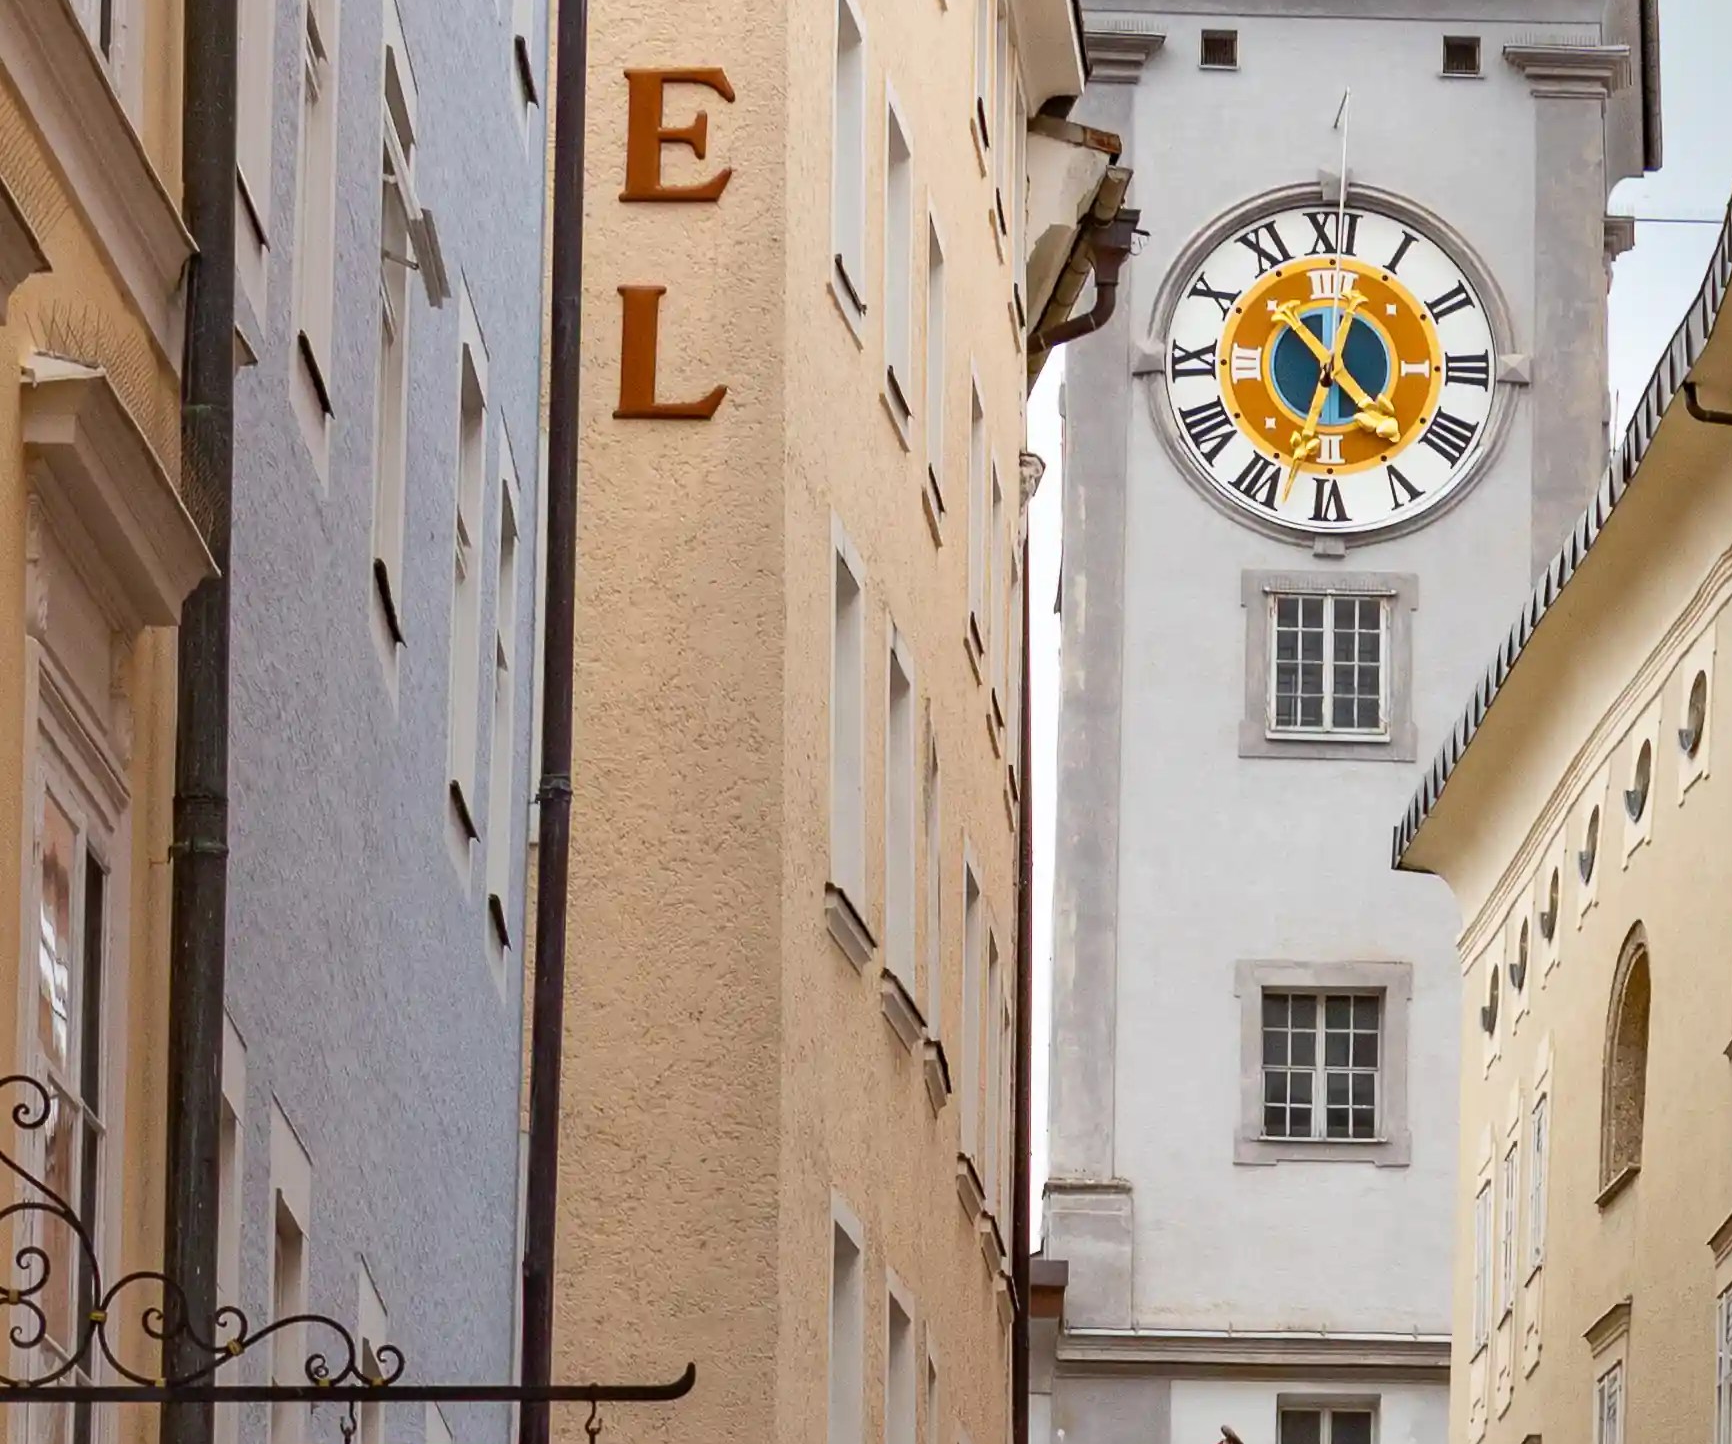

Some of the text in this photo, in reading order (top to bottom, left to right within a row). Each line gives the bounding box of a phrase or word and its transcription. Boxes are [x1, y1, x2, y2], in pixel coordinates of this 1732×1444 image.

[1234, 220, 1296, 278] XI
[1303, 212, 1363, 256] XII
[1383, 231, 1419, 274] I
[1187, 272, 1242, 321] X
[1424, 280, 1476, 324] II
[1172, 339, 1218, 383] IX
[1445, 349, 1489, 392] III
[1179, 396, 1237, 467] VIII
[1419, 406, 1479, 468] IIII
[1228, 451, 1283, 511] VII
[1308, 478, 1352, 522] VI
[1387, 465, 1425, 510] V
